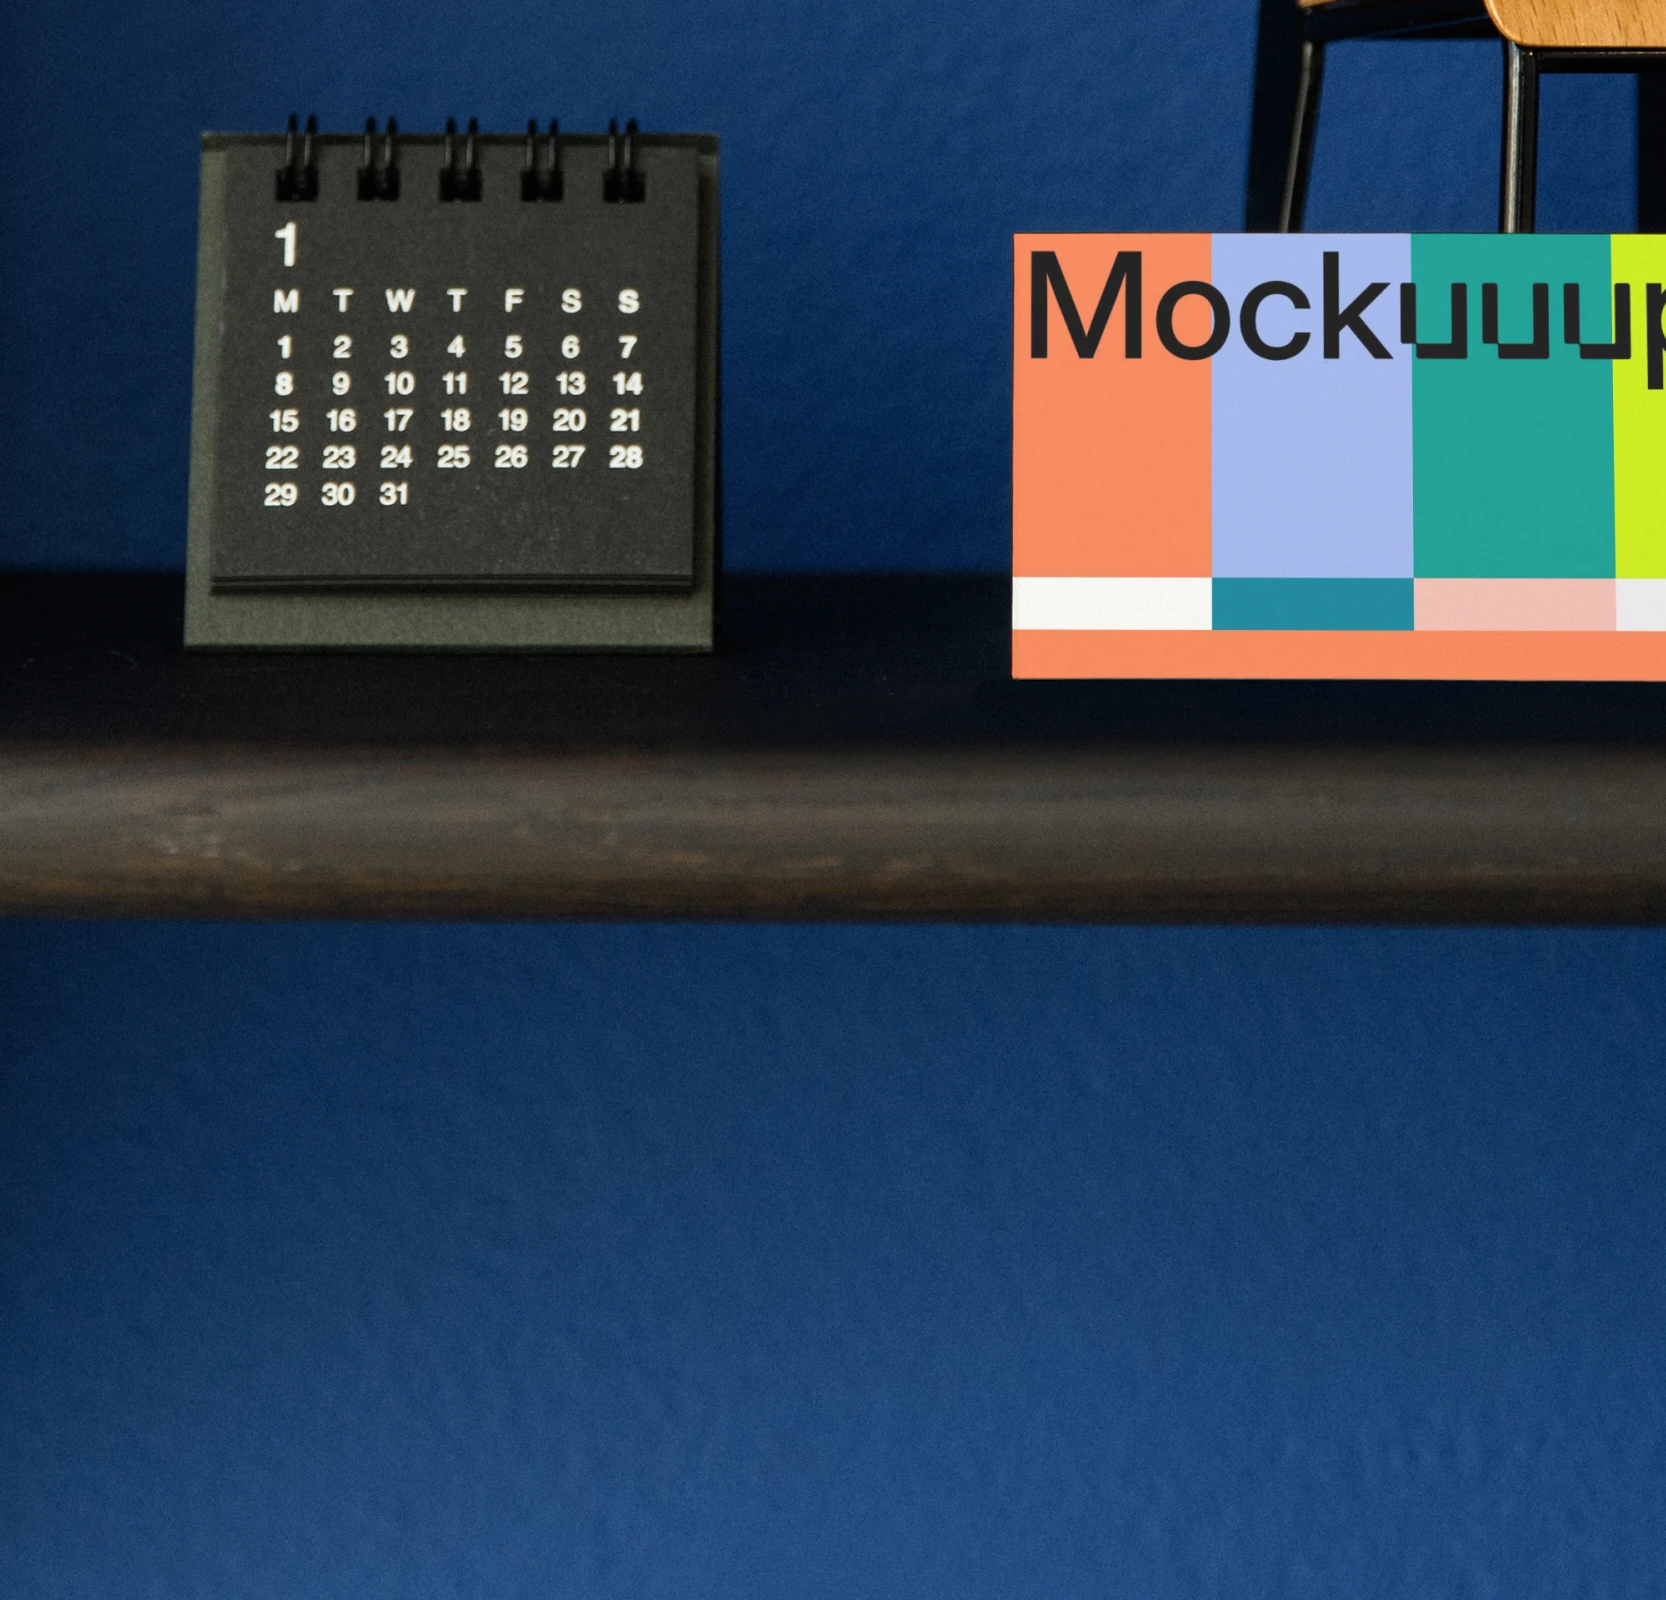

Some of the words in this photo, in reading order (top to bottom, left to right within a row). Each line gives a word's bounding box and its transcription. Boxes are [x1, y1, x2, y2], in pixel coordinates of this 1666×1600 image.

[274, 221, 297, 267] 1
[273, 288, 300, 314] M
[332, 288, 354, 313] T
[385, 288, 416, 313] W
[446, 287, 468, 313] T
[504, 288, 525, 313] F
[560, 288, 583, 314] S
[617, 288, 640, 314] S
[277, 334, 292, 359] 1
[332, 334, 353, 359] 2
[389, 334, 409, 359] 3
[446, 334, 467, 359] 4
[504, 334, 523, 359] 5
[561, 334, 581, 359] 6
[618, 334, 638, 359] 7
[274, 371, 294, 397] 8
[332, 370, 351, 396] 9
[384, 370, 416, 396] 10
[441, 371, 468, 395] 11
[498, 370, 530, 395] 12
[555, 371, 587, 396] 13
[612, 371, 644, 396] 14
[268, 408, 300, 433] 15
[325, 407, 357, 433] 16
[383, 407, 414, 432] 17
[440, 407, 472, 433] 18
[497, 407, 529, 432] 19
[552, 407, 587, 433] 20
[609, 407, 641, 432] 21
[264, 444, 300, 470] 22
[321, 444, 357, 470] 23
[379, 444, 414, 469] 24
[436, 444, 472, 469] 25
[494, 444, 529, 469] 26
[551, 444, 587, 469] 27
[608, 444, 644, 470] 28
[263, 482, 299, 507] 29
[320, 481, 356, 507] 30
[378, 481, 409, 506] 31
